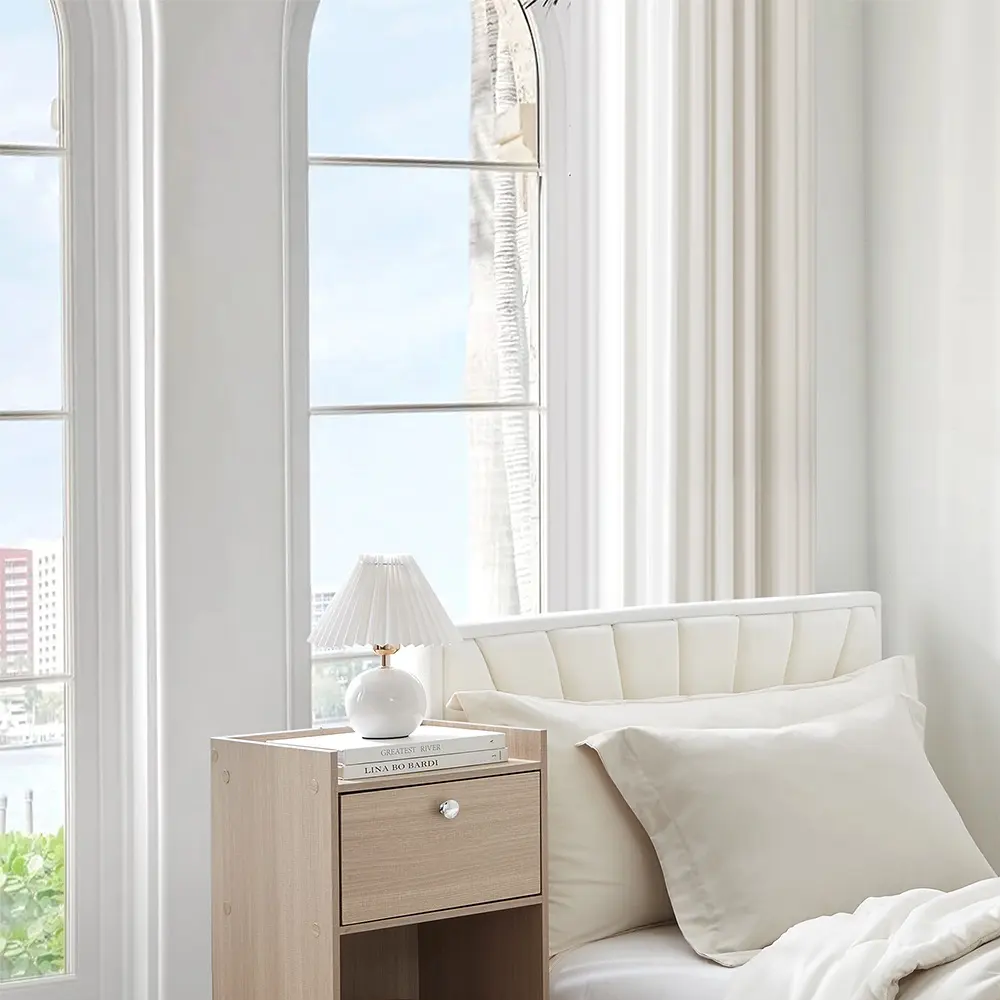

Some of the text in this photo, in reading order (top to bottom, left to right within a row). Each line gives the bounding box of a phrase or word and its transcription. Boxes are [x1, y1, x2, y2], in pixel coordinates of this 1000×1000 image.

[380, 743, 441, 757] GREATEST RIVER
[364, 759, 438, 774] LINA BO BARDI
